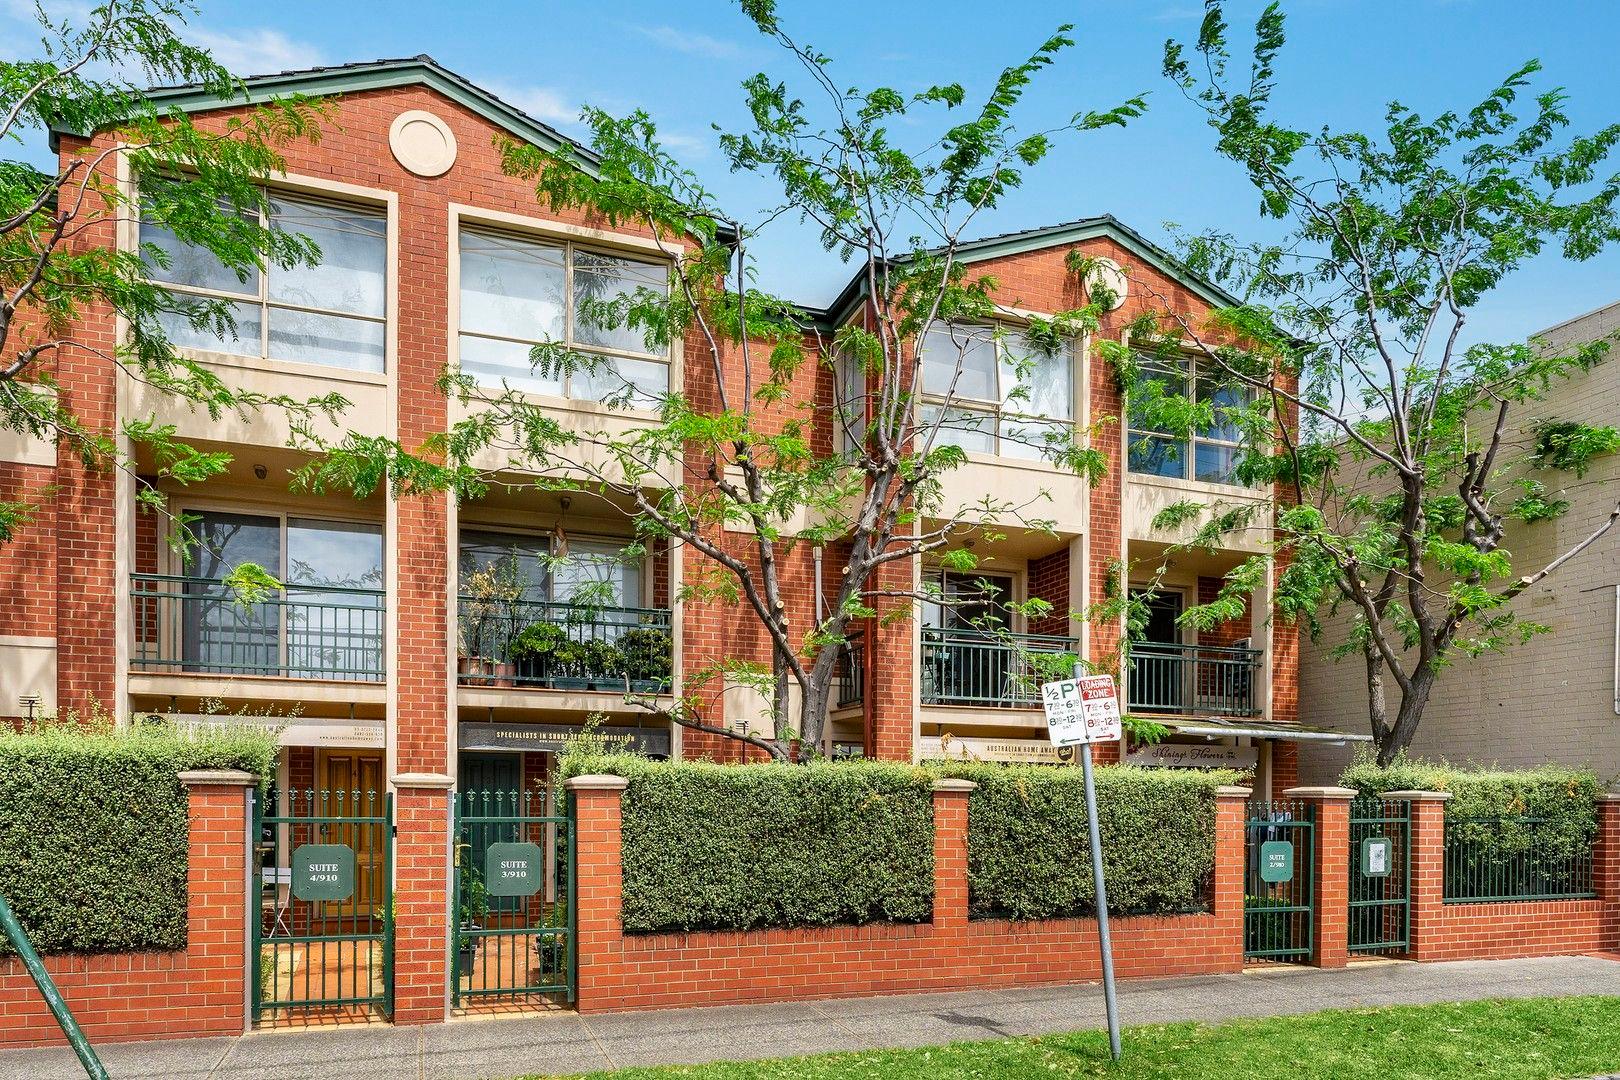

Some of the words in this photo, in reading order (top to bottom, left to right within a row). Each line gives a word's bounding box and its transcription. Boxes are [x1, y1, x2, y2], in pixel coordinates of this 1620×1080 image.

[1081, 678, 1112, 690] LOADING
[1061, 683, 1074, 698] P
[1088, 689, 1110, 699] ZONE
